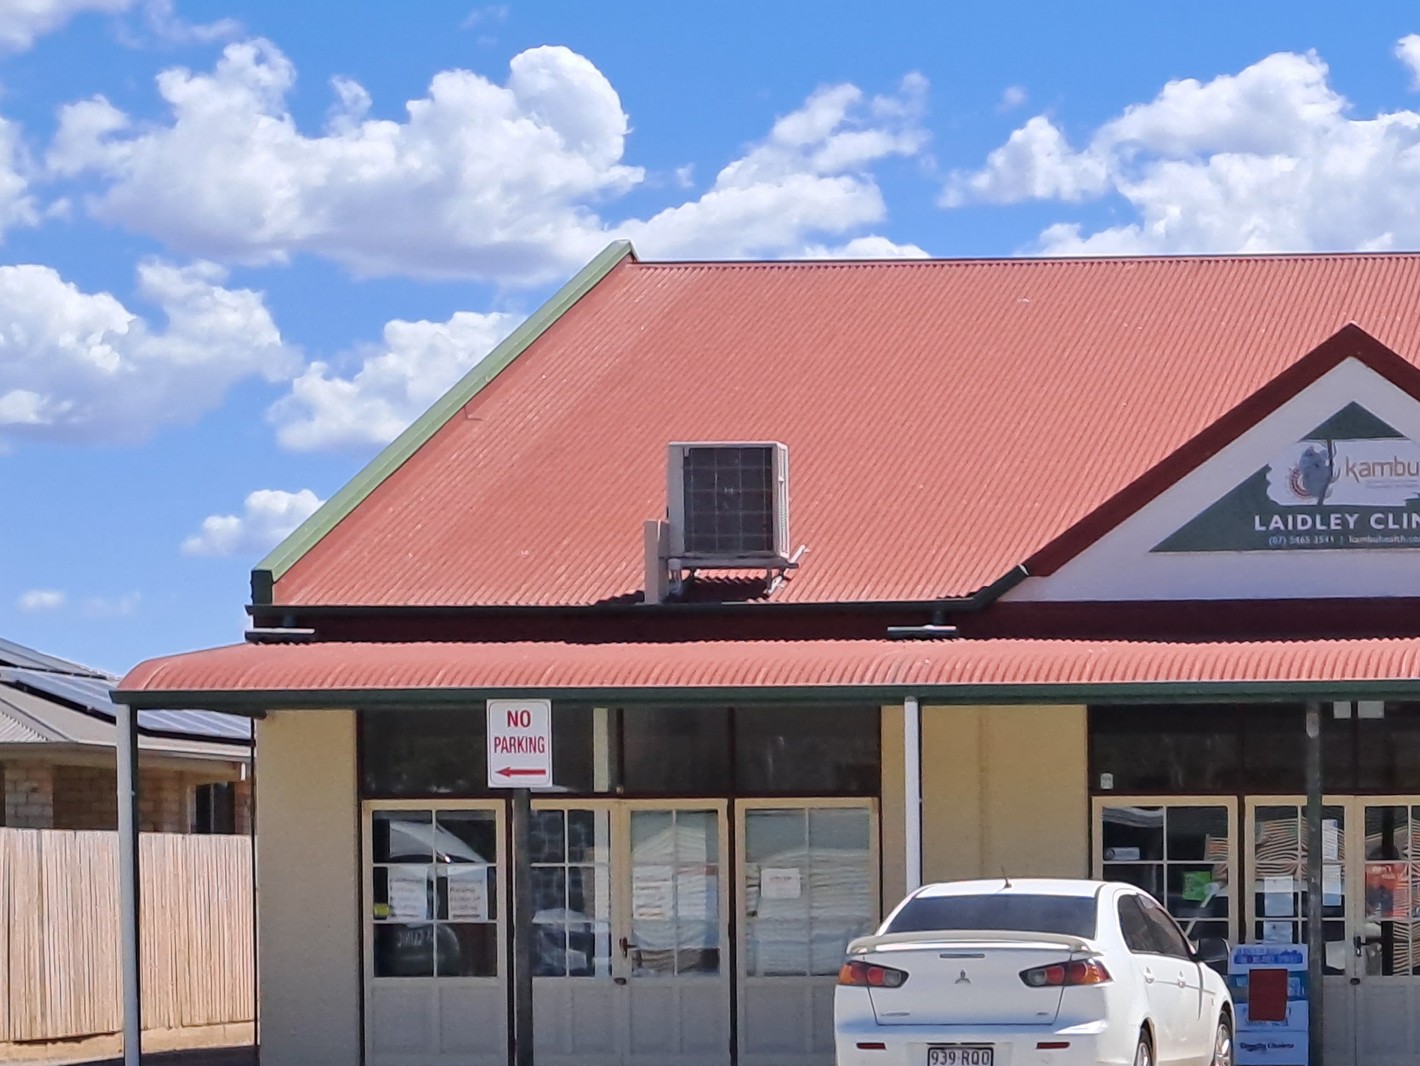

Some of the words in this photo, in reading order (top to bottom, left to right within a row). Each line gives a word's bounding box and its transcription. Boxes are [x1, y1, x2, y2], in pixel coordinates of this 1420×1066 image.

[1345, 455, 1420, 483] kambu
[1254, 513, 1360, 531] LAIDLEY
[506, 709, 531, 728] NO
[494, 735, 545, 754] PARKING
[930, 1050, 957, 1066] 939
